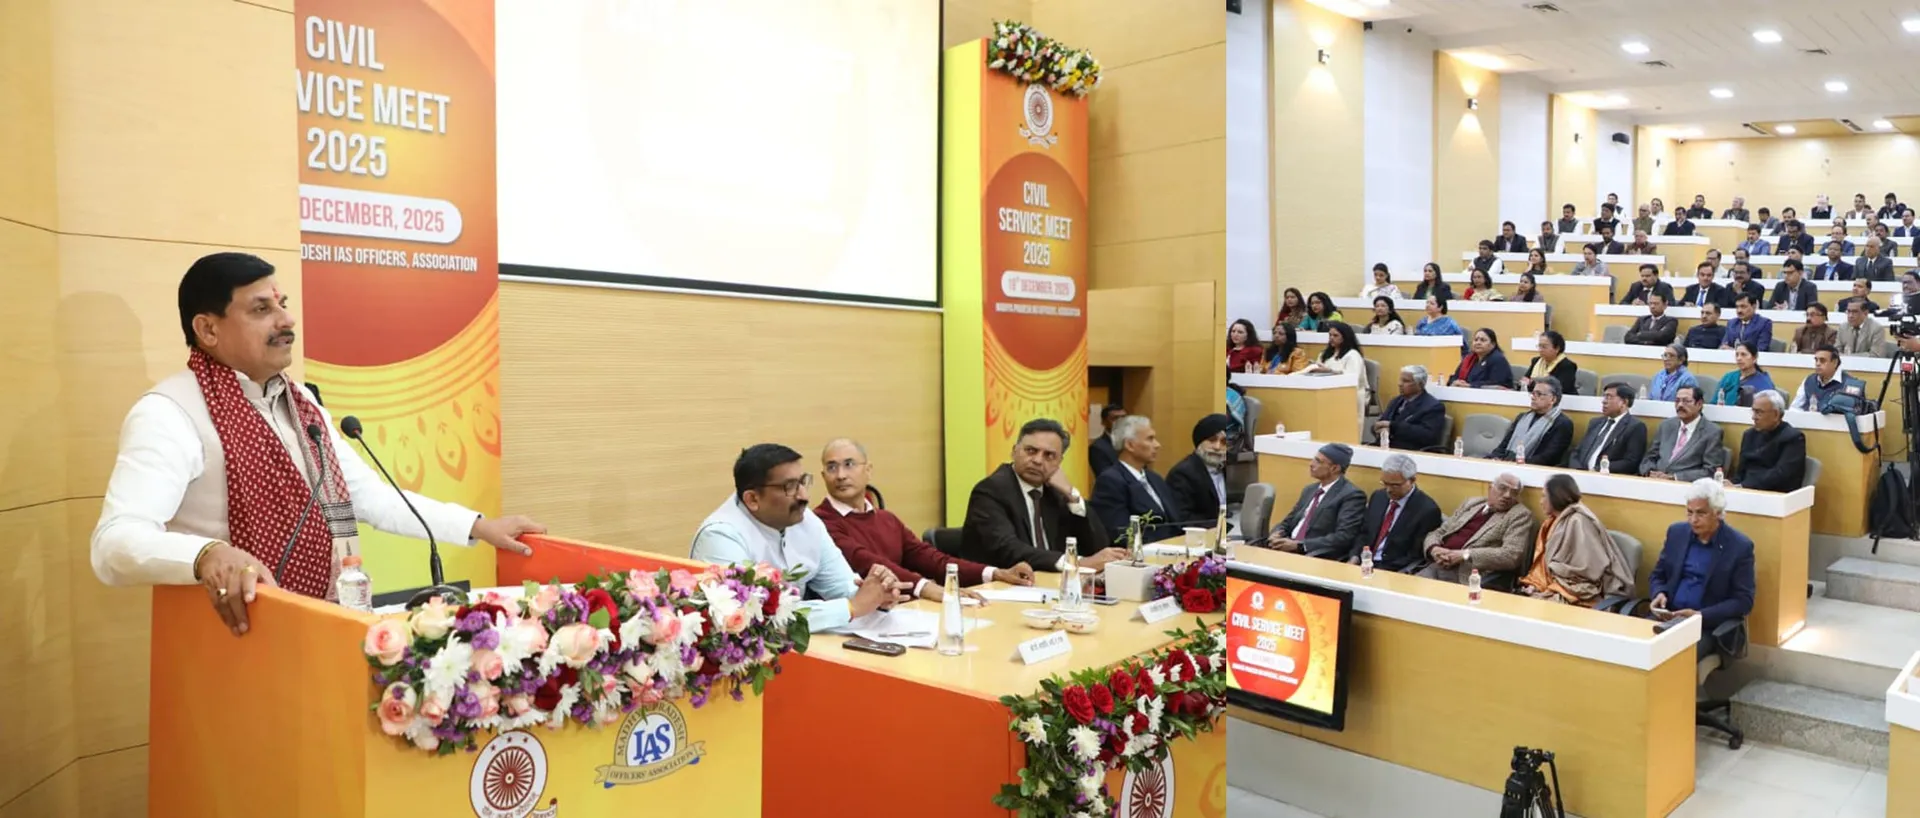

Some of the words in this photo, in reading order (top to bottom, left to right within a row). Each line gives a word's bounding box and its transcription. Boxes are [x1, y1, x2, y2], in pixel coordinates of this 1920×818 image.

[305, 15, 384, 71] CIVIL
[373, 82, 450, 134] MEET
[307, 127, 388, 178] 2025
[1023, 181, 1049, 207] CIVIL
[300, 196, 398, 231] DECEMBER,
[403, 207, 445, 233] 2025
[999, 207, 1043, 236] SERVICE
[1045, 215, 1073, 240] MEET
[301, 243, 331, 261] DESH
[334, 248, 352, 263] IAS
[355, 249, 410, 269] OFFICERS,
[412, 254, 477, 272] ASSOCIATION
[1023, 241, 1051, 266] 2025
[1232, 612, 1251, 629] CIVIL
[1251, 617, 1283, 637] SERVICE
[1284, 624, 1306, 642] MEET
[617, 707, 646, 757] MADHY
[633, 723, 671, 765] IAS
